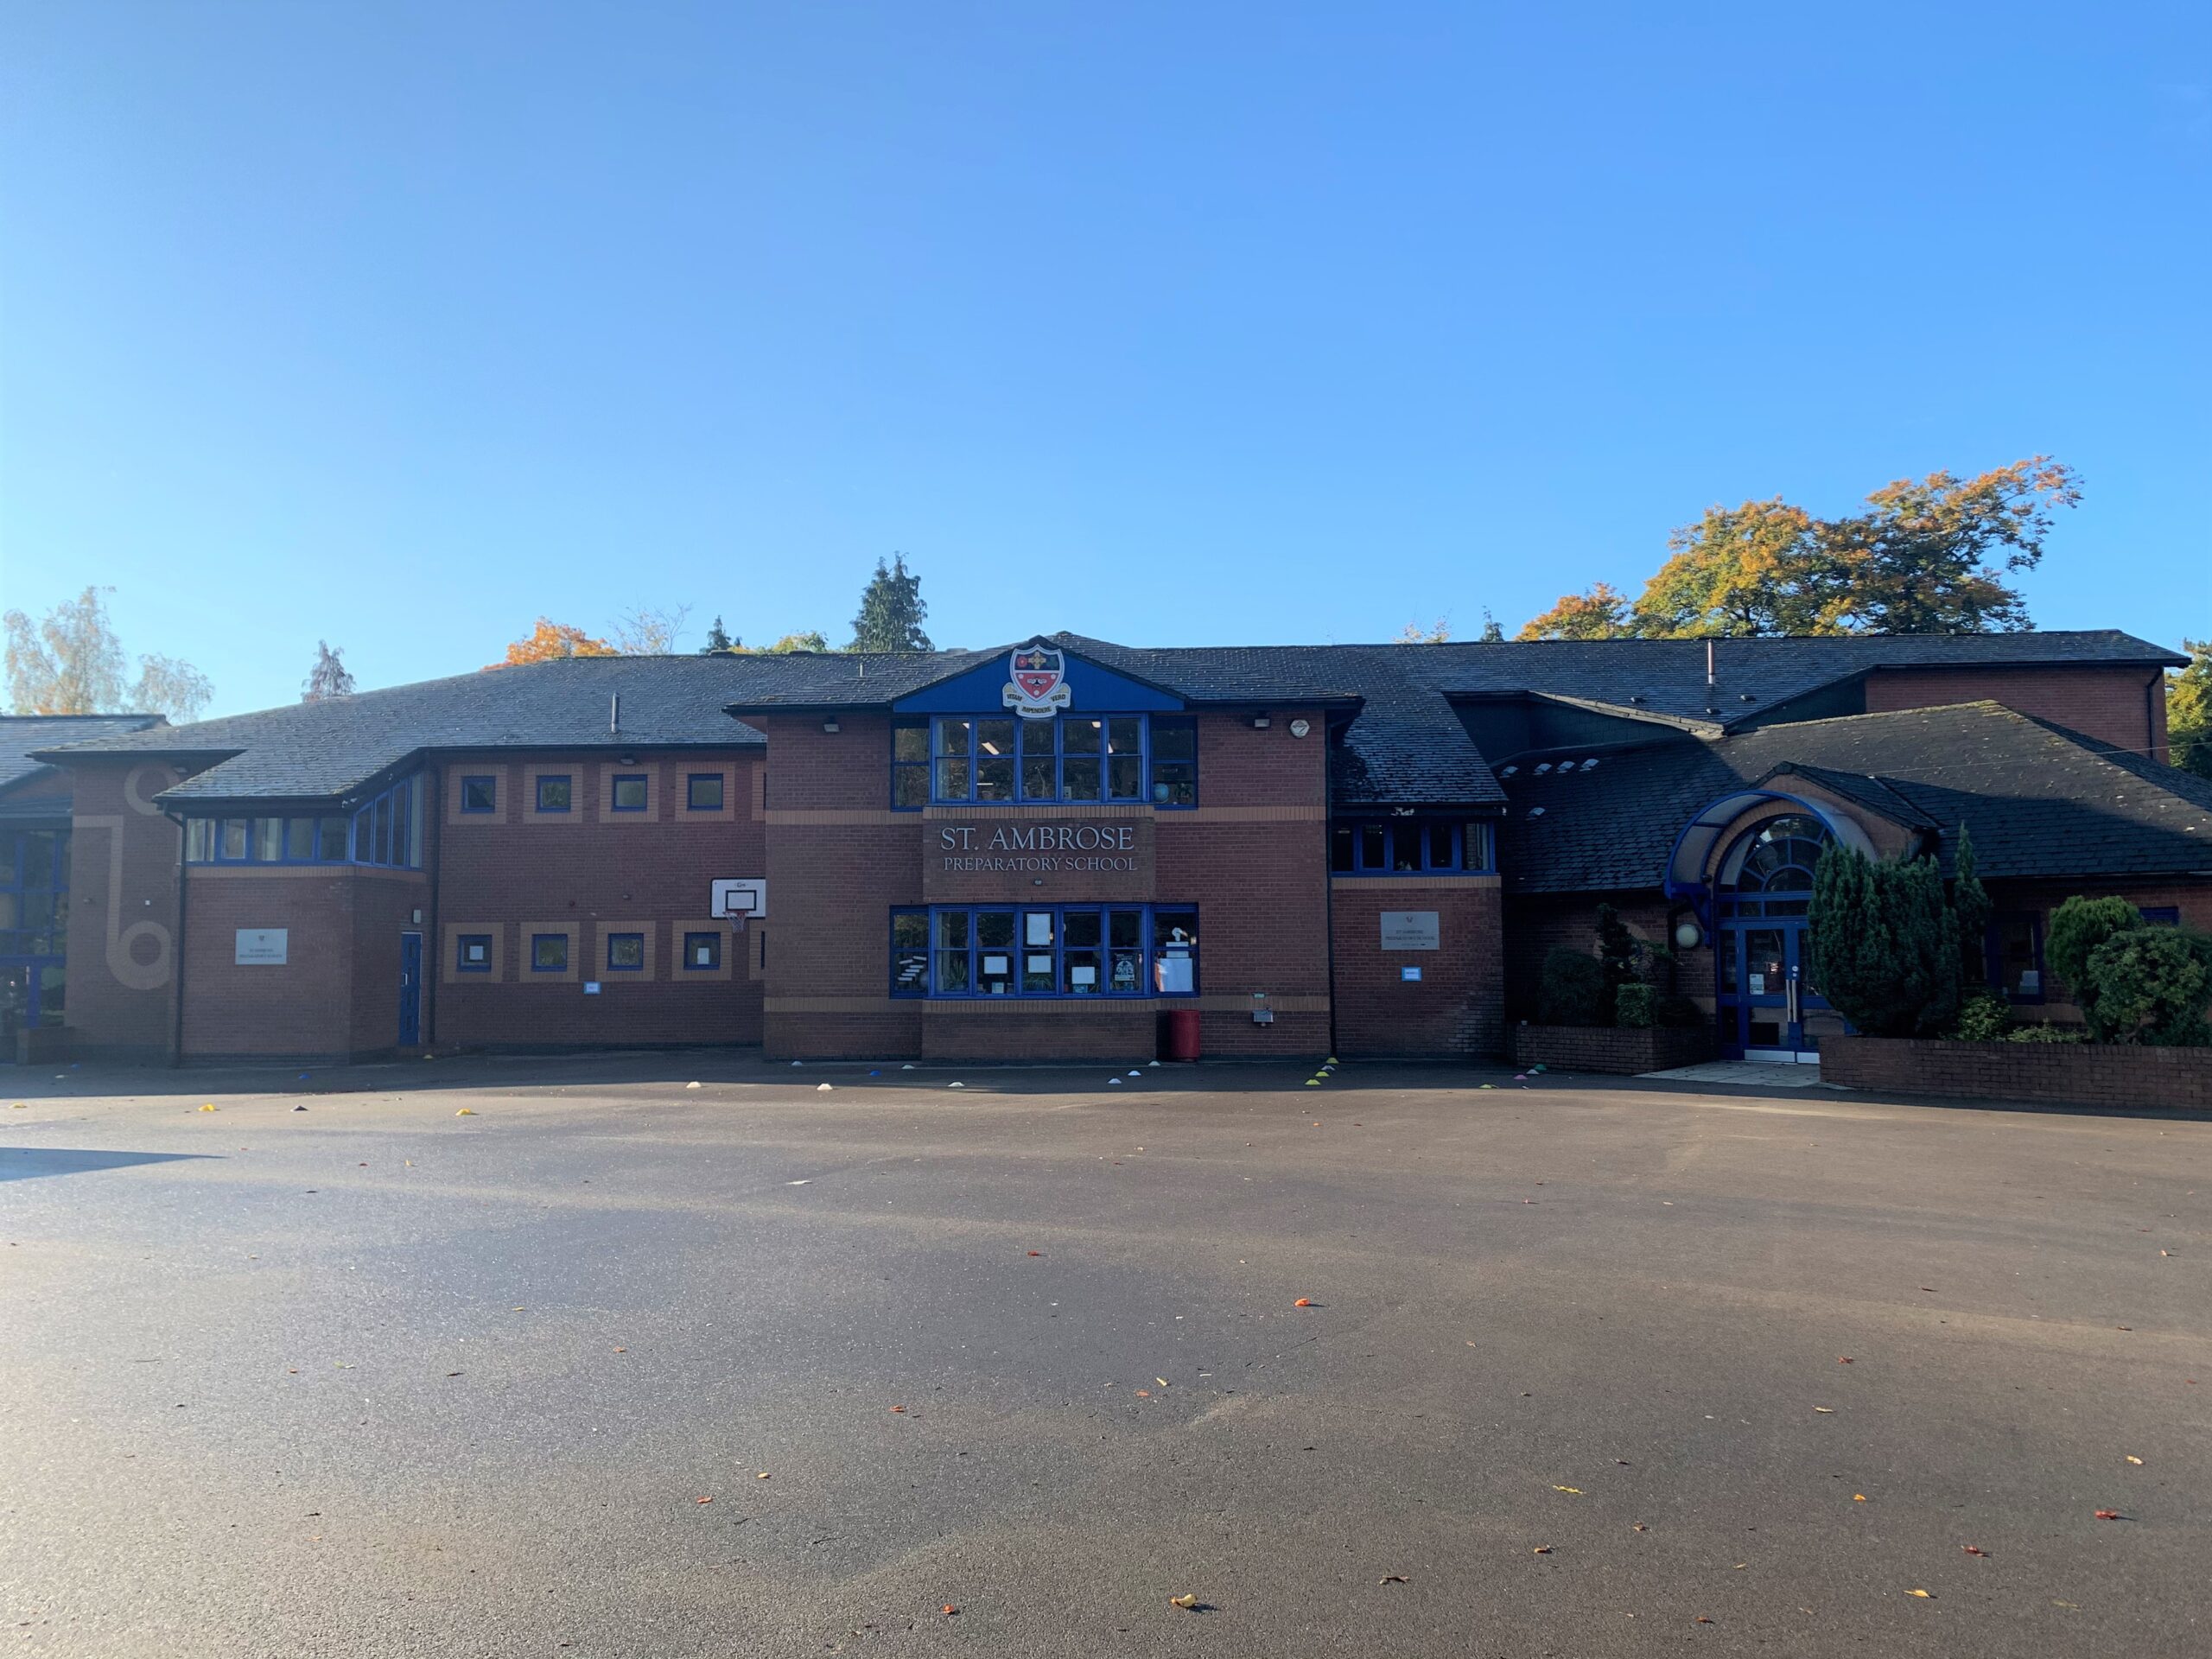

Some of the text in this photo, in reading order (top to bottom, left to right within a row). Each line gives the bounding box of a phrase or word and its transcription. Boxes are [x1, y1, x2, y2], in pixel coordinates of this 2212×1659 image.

[941, 826, 1135, 851] ST. AMBROSE
[944, 856, 1138, 872] PREPARATORY SCHOOL
